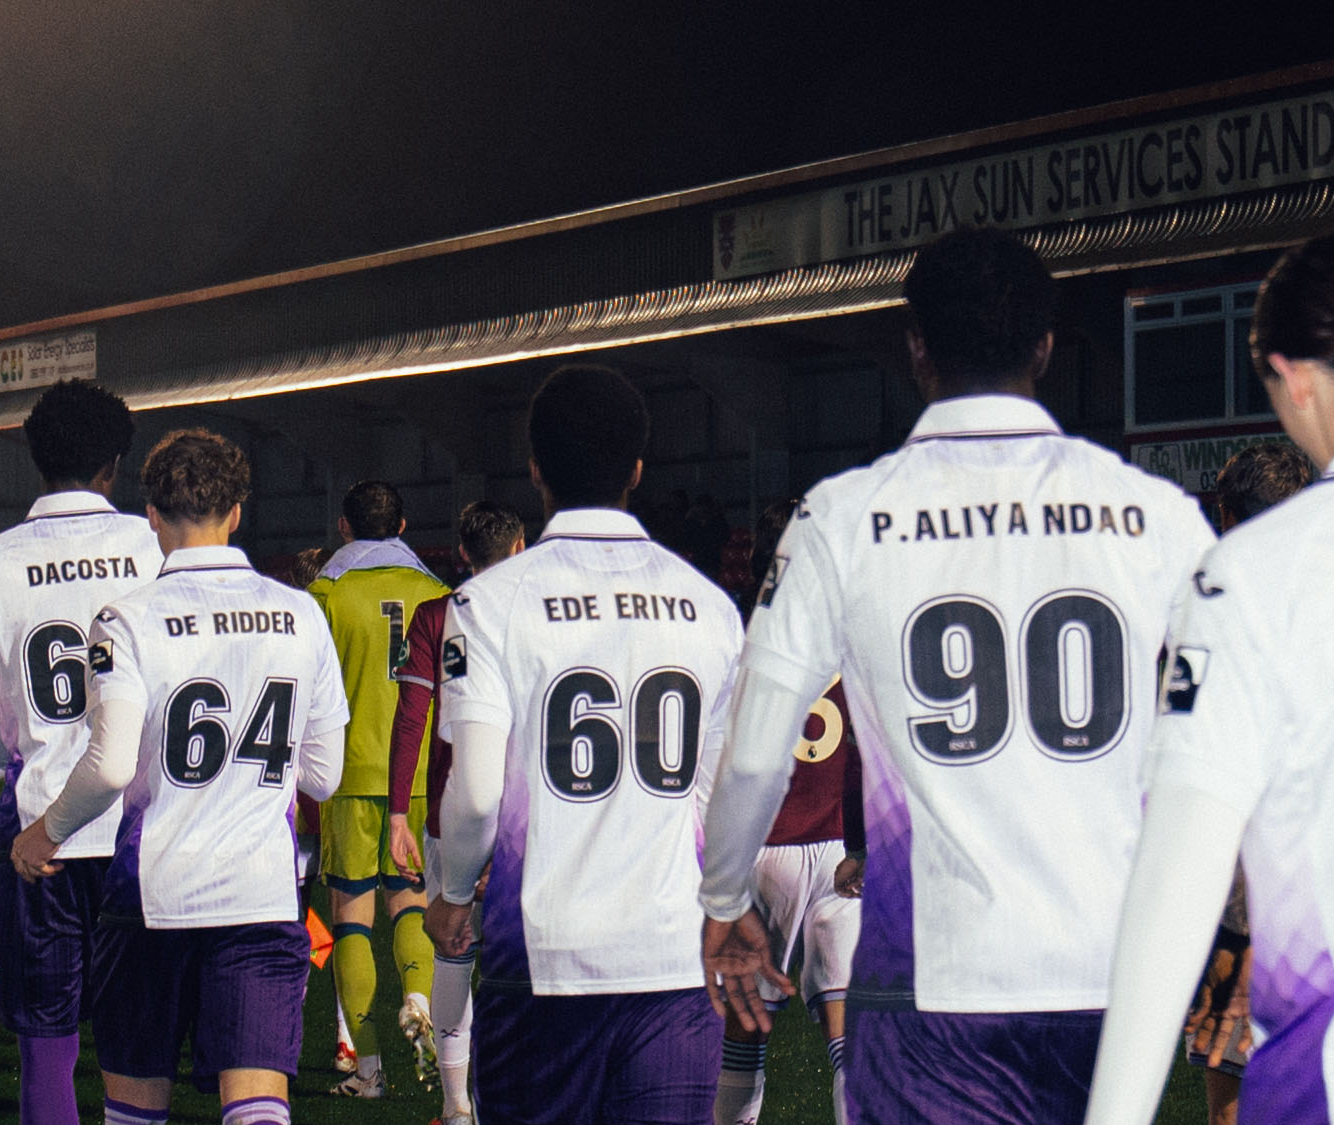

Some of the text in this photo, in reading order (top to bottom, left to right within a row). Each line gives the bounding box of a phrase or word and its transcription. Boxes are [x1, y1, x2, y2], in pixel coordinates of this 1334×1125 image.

[844, 184, 893, 248] THE
[900, 172, 961, 238] JAX
[972, 156, 1036, 225] SUN
[1047, 124, 1204, 210] SERVICES
[27, 556, 138, 587] DACOSTA
[165, 610, 296, 637] DE RIDDER
[543, 591, 698, 623] EDE ERIYO
[23, 619, 89, 725] 6
[901, 587, 1131, 767] 90
[161, 677, 298, 789] 64
[540, 665, 704, 804] 60
